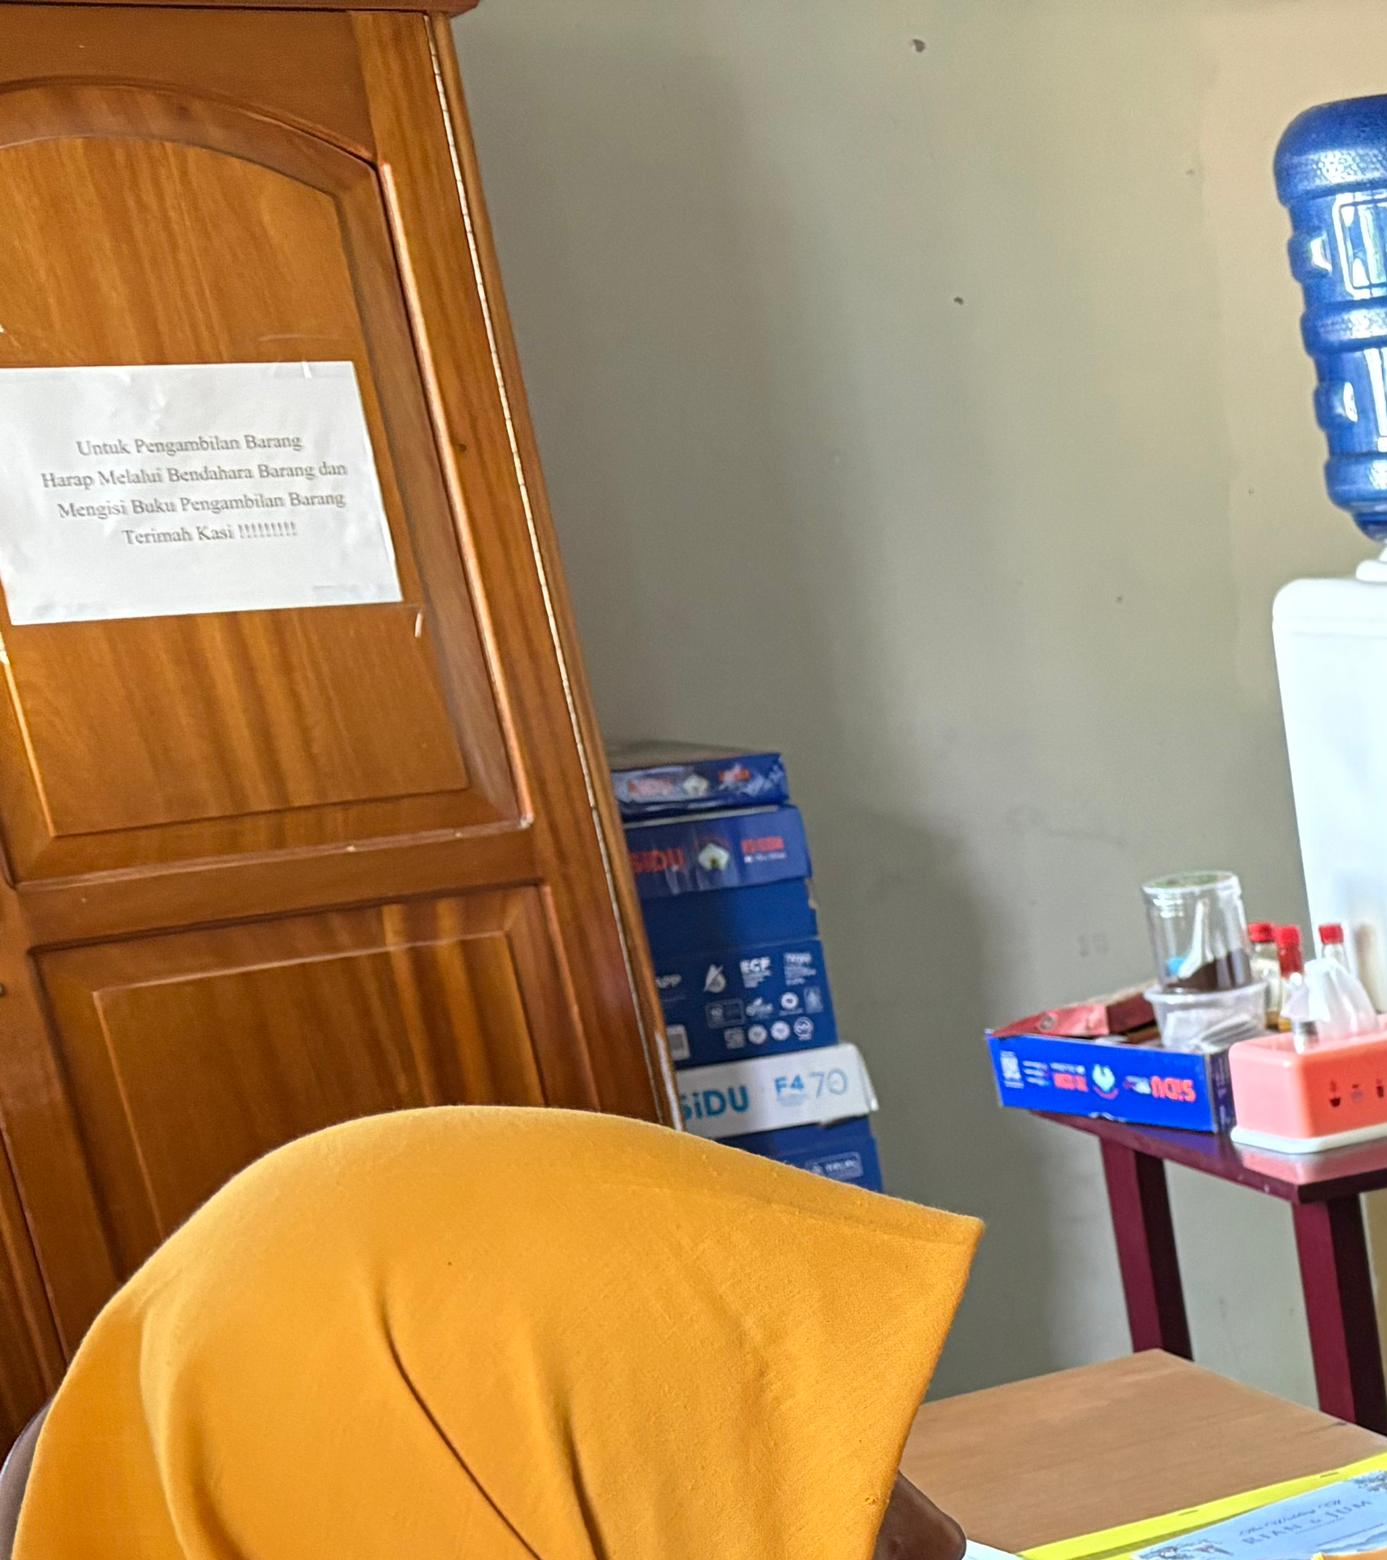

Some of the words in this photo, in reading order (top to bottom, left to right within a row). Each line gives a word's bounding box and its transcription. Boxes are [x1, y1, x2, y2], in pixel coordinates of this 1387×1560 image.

[76, 439, 131, 456] Untuk
[135, 434, 241, 457] Pengambilan
[245, 434, 303, 454] Barang
[41, 471, 95, 490] Harap
[99, 468, 163, 486] Melalui
[168, 465, 255, 483] Bendahara
[259, 463, 315, 482] Barang
[319, 460, 347, 476] dan
[57, 499, 127, 520] Mengisi
[131, 497, 177, 514] Buku
[181, 493, 284, 516] Pengambilan
[289, 491, 345, 511] Barang
[122, 528, 193, 545] Terimah
[197, 524, 234, 541] Kasi
